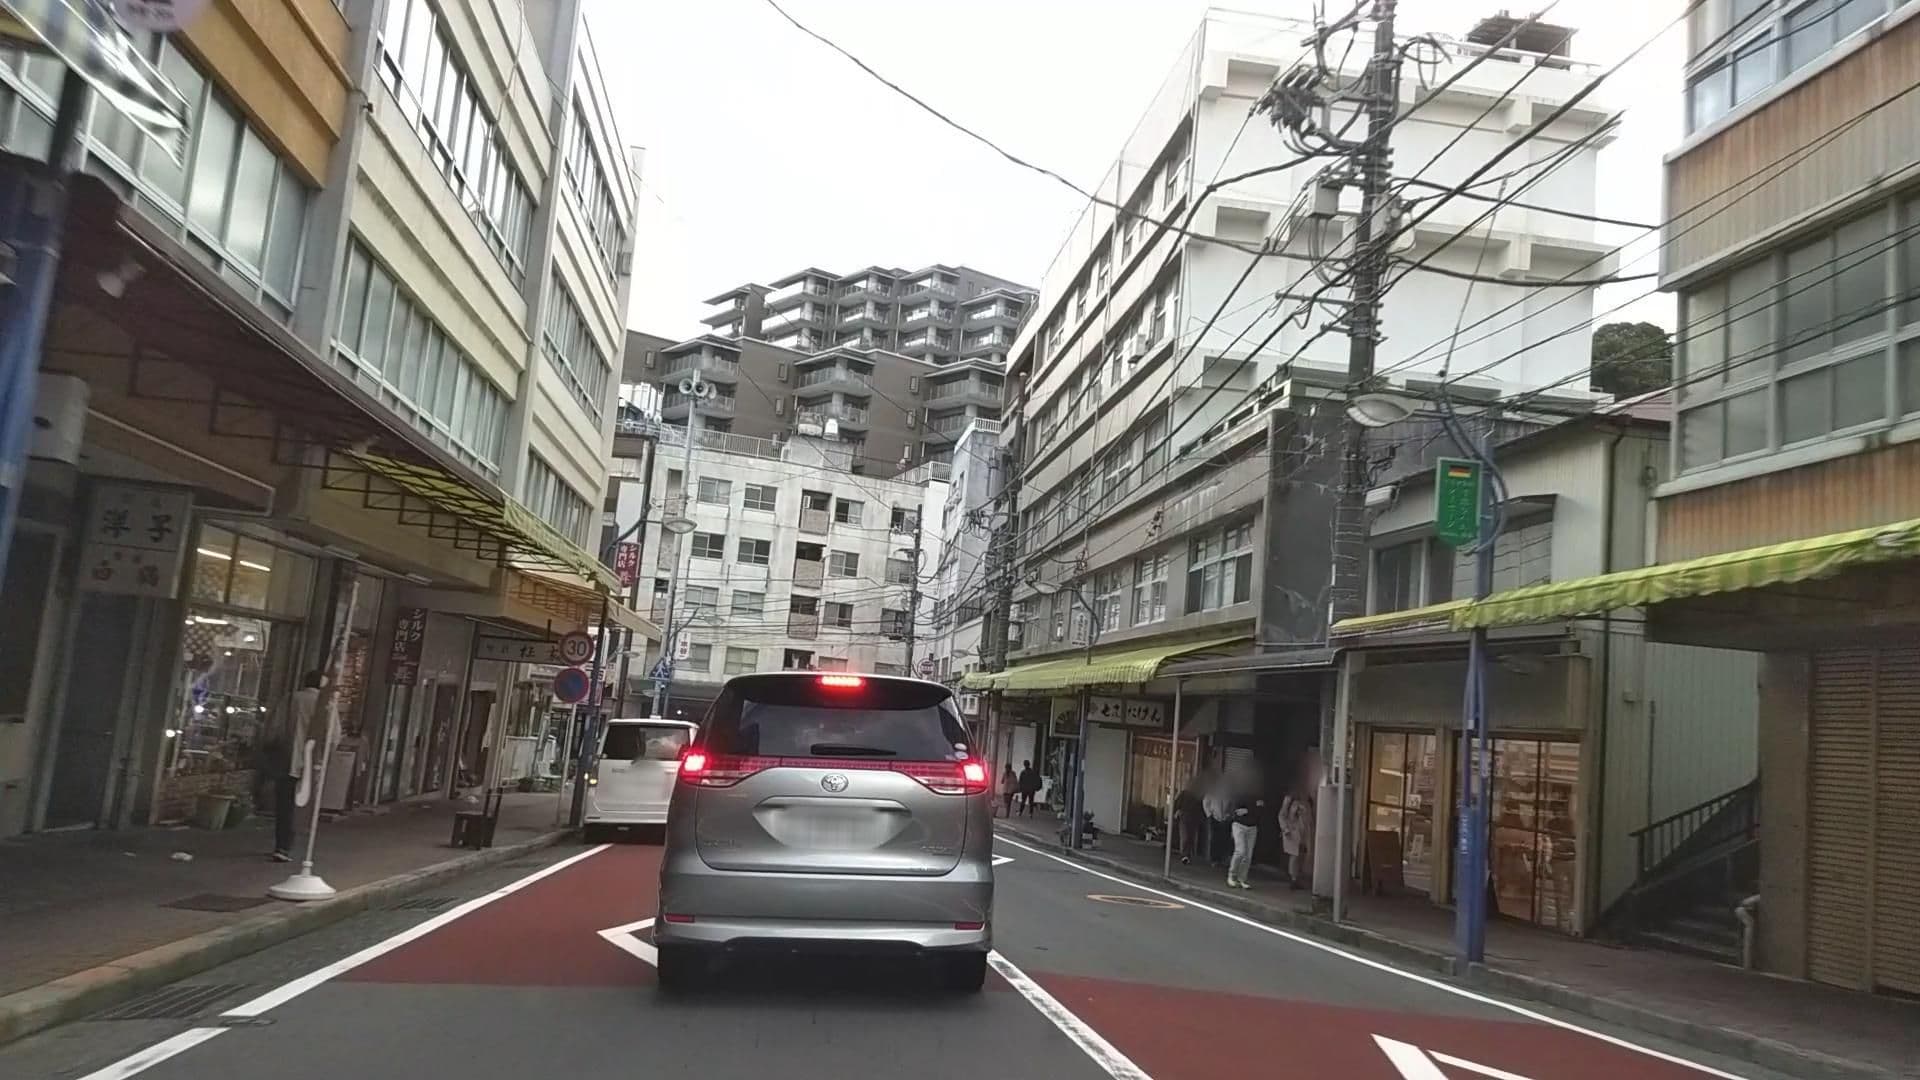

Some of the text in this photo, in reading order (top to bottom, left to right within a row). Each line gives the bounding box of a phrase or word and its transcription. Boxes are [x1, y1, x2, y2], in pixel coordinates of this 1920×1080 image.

[410, 608, 424, 640] シルク
[567, 640, 587, 656] 30
